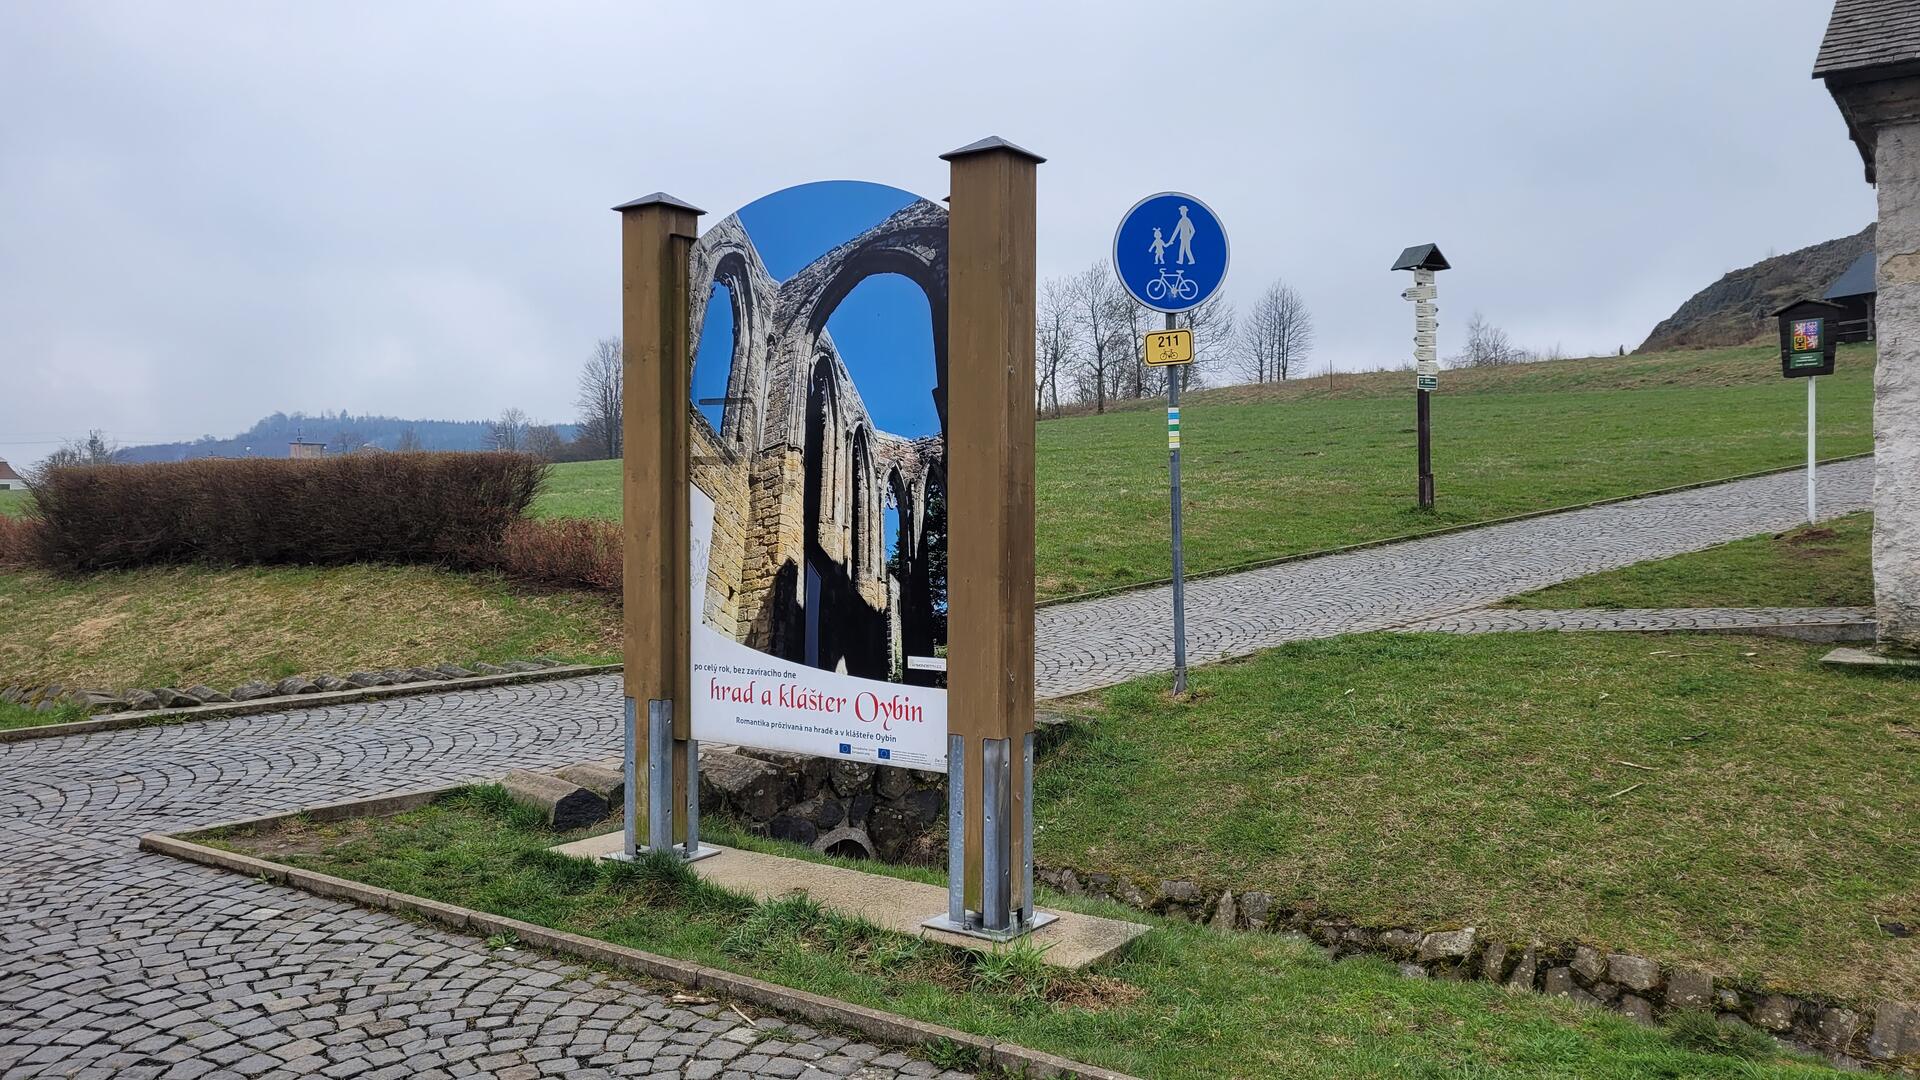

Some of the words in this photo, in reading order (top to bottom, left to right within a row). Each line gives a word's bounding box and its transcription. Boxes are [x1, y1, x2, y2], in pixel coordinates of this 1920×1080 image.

[1158, 335, 1178, 347] 211
[694, 664, 702, 672] po
[704, 664, 717, 674] celý
[718, 665, 732, 674] rok,
[733, 666, 745, 674] bez
[783, 670, 797, 679] dne
[711, 677, 756, 704] hrad
[761, 689, 772, 706] a
[779, 683, 847, 713] klášter
[855, 691, 923, 731] Oybin
[736, 717, 769, 728] Romantika
[814, 726, 834, 735] hradě
[845, 729, 874, 740] klášteře
[875, 733, 897, 743] Oybin
